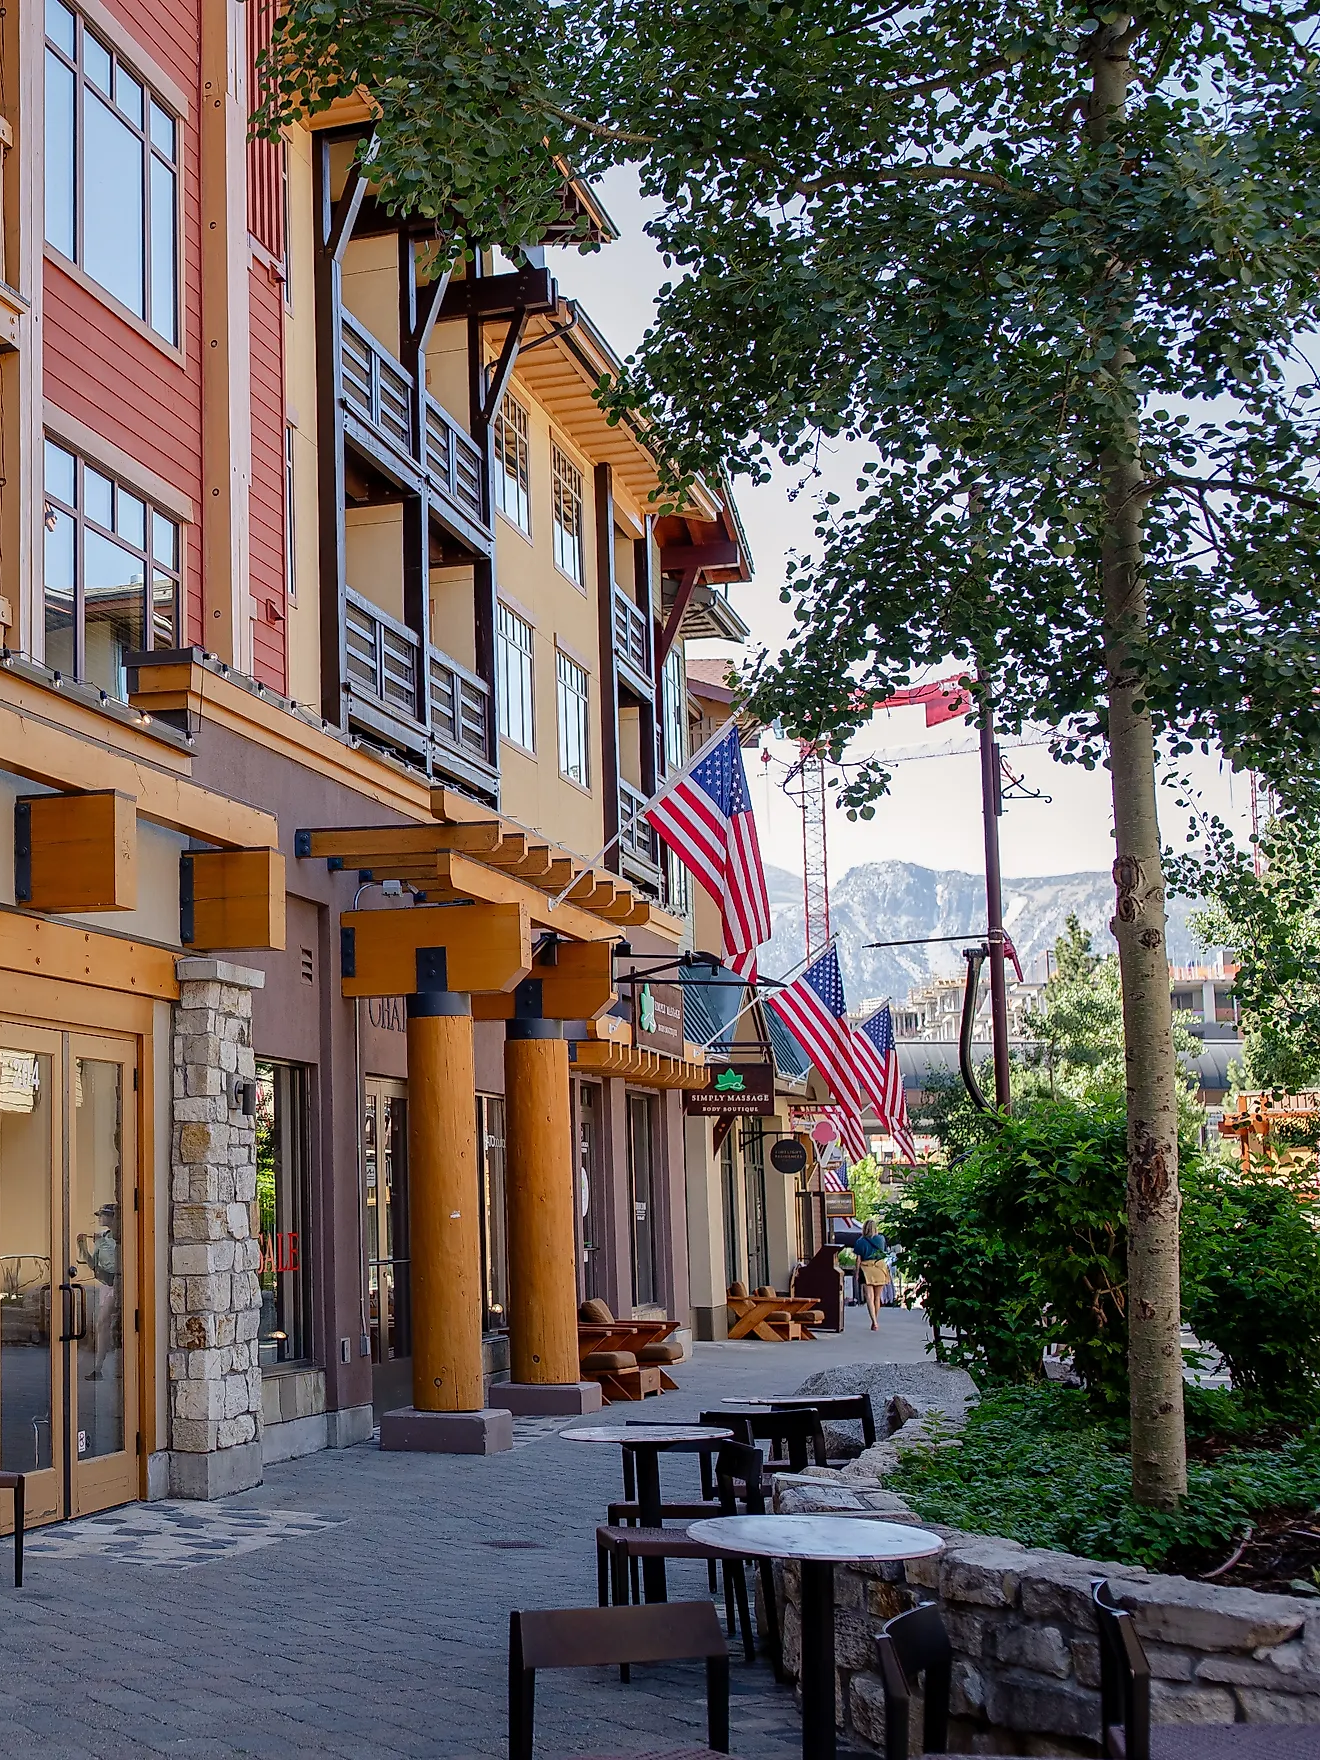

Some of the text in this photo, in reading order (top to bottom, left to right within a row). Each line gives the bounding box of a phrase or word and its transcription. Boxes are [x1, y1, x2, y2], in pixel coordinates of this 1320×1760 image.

[369, 996, 407, 1033] CHA
[691, 1094, 770, 1102] SIMPLY MASSAGE
